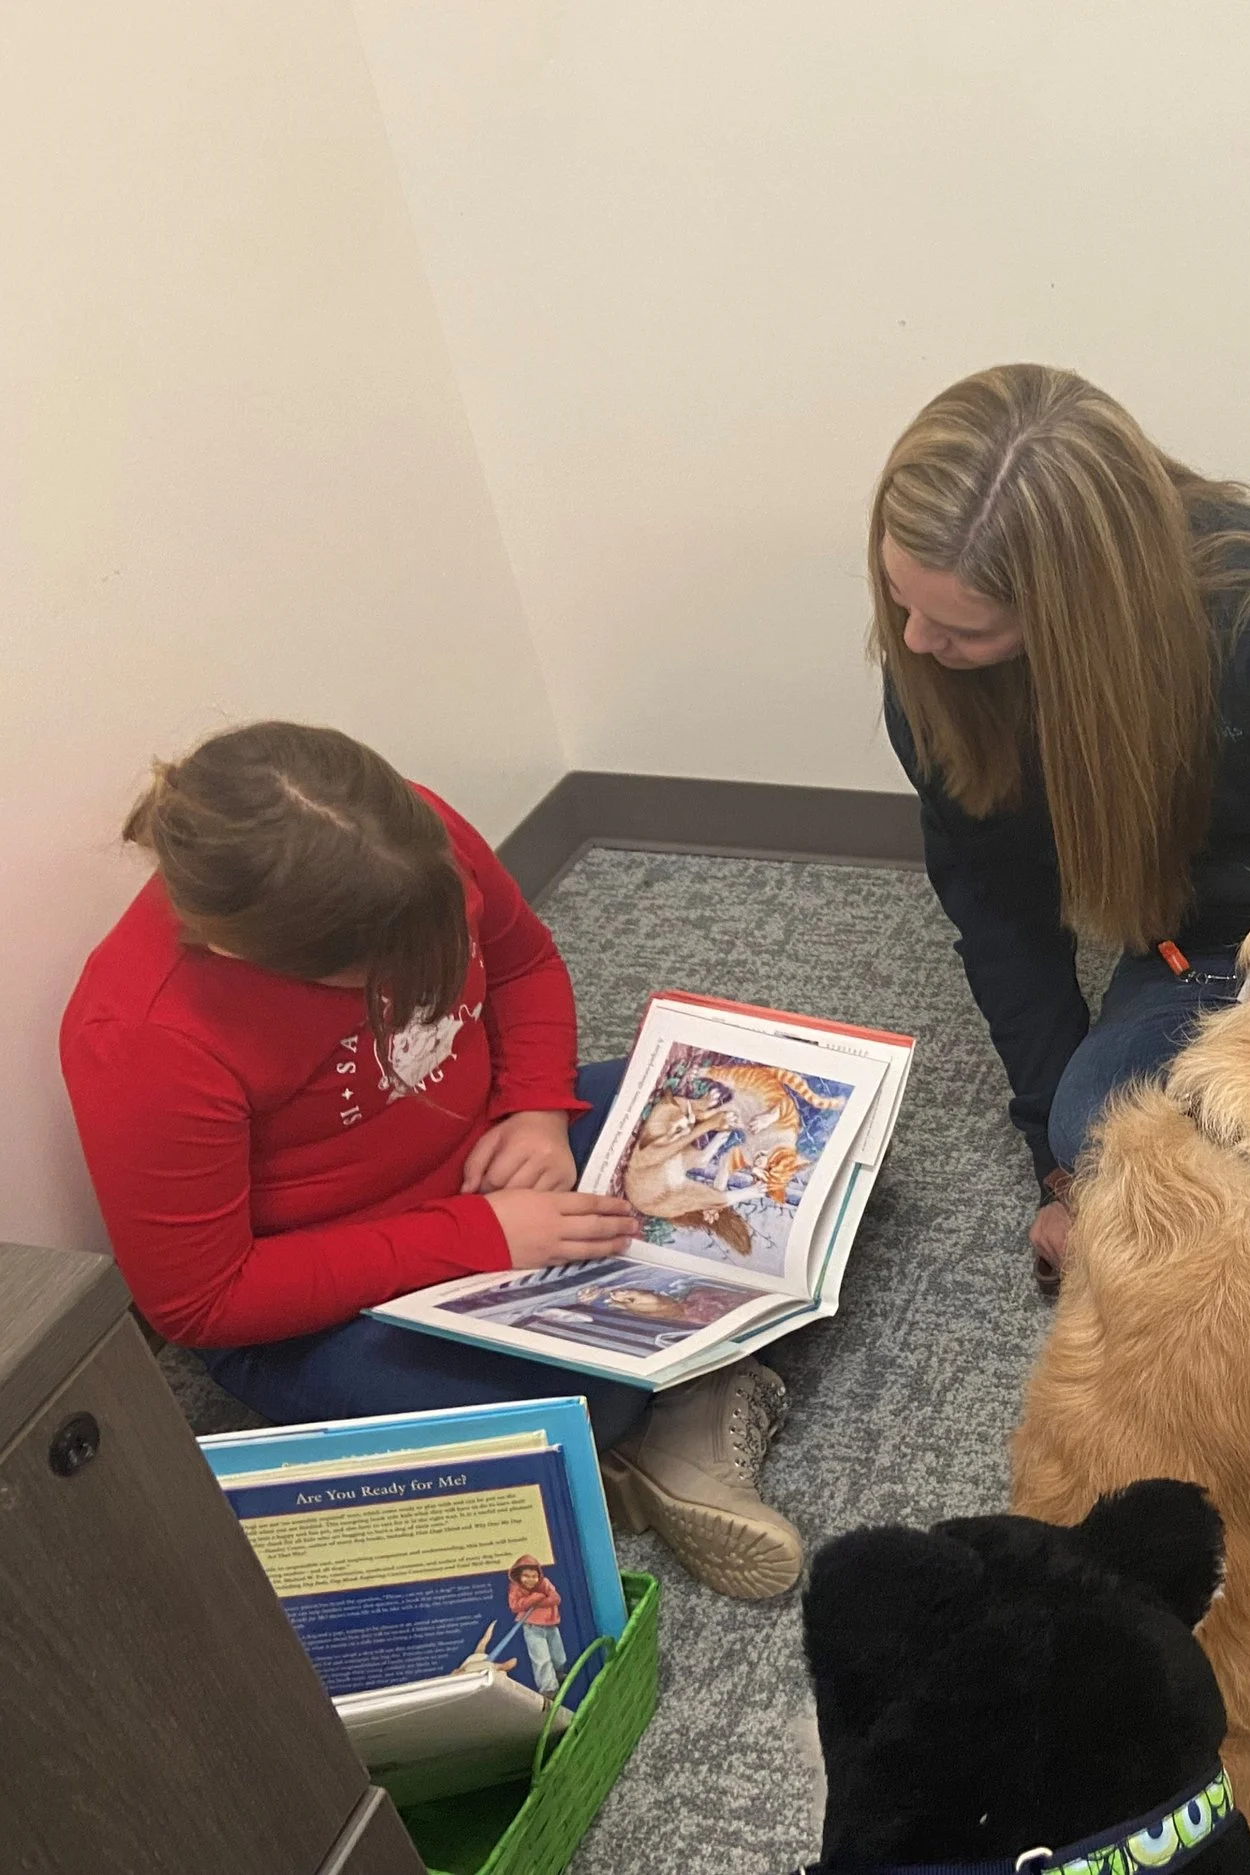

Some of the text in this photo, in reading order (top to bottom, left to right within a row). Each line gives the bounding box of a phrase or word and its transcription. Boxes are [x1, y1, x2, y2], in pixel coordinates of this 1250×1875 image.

[296, 1474, 467, 1505] Are You Ready for Me?
